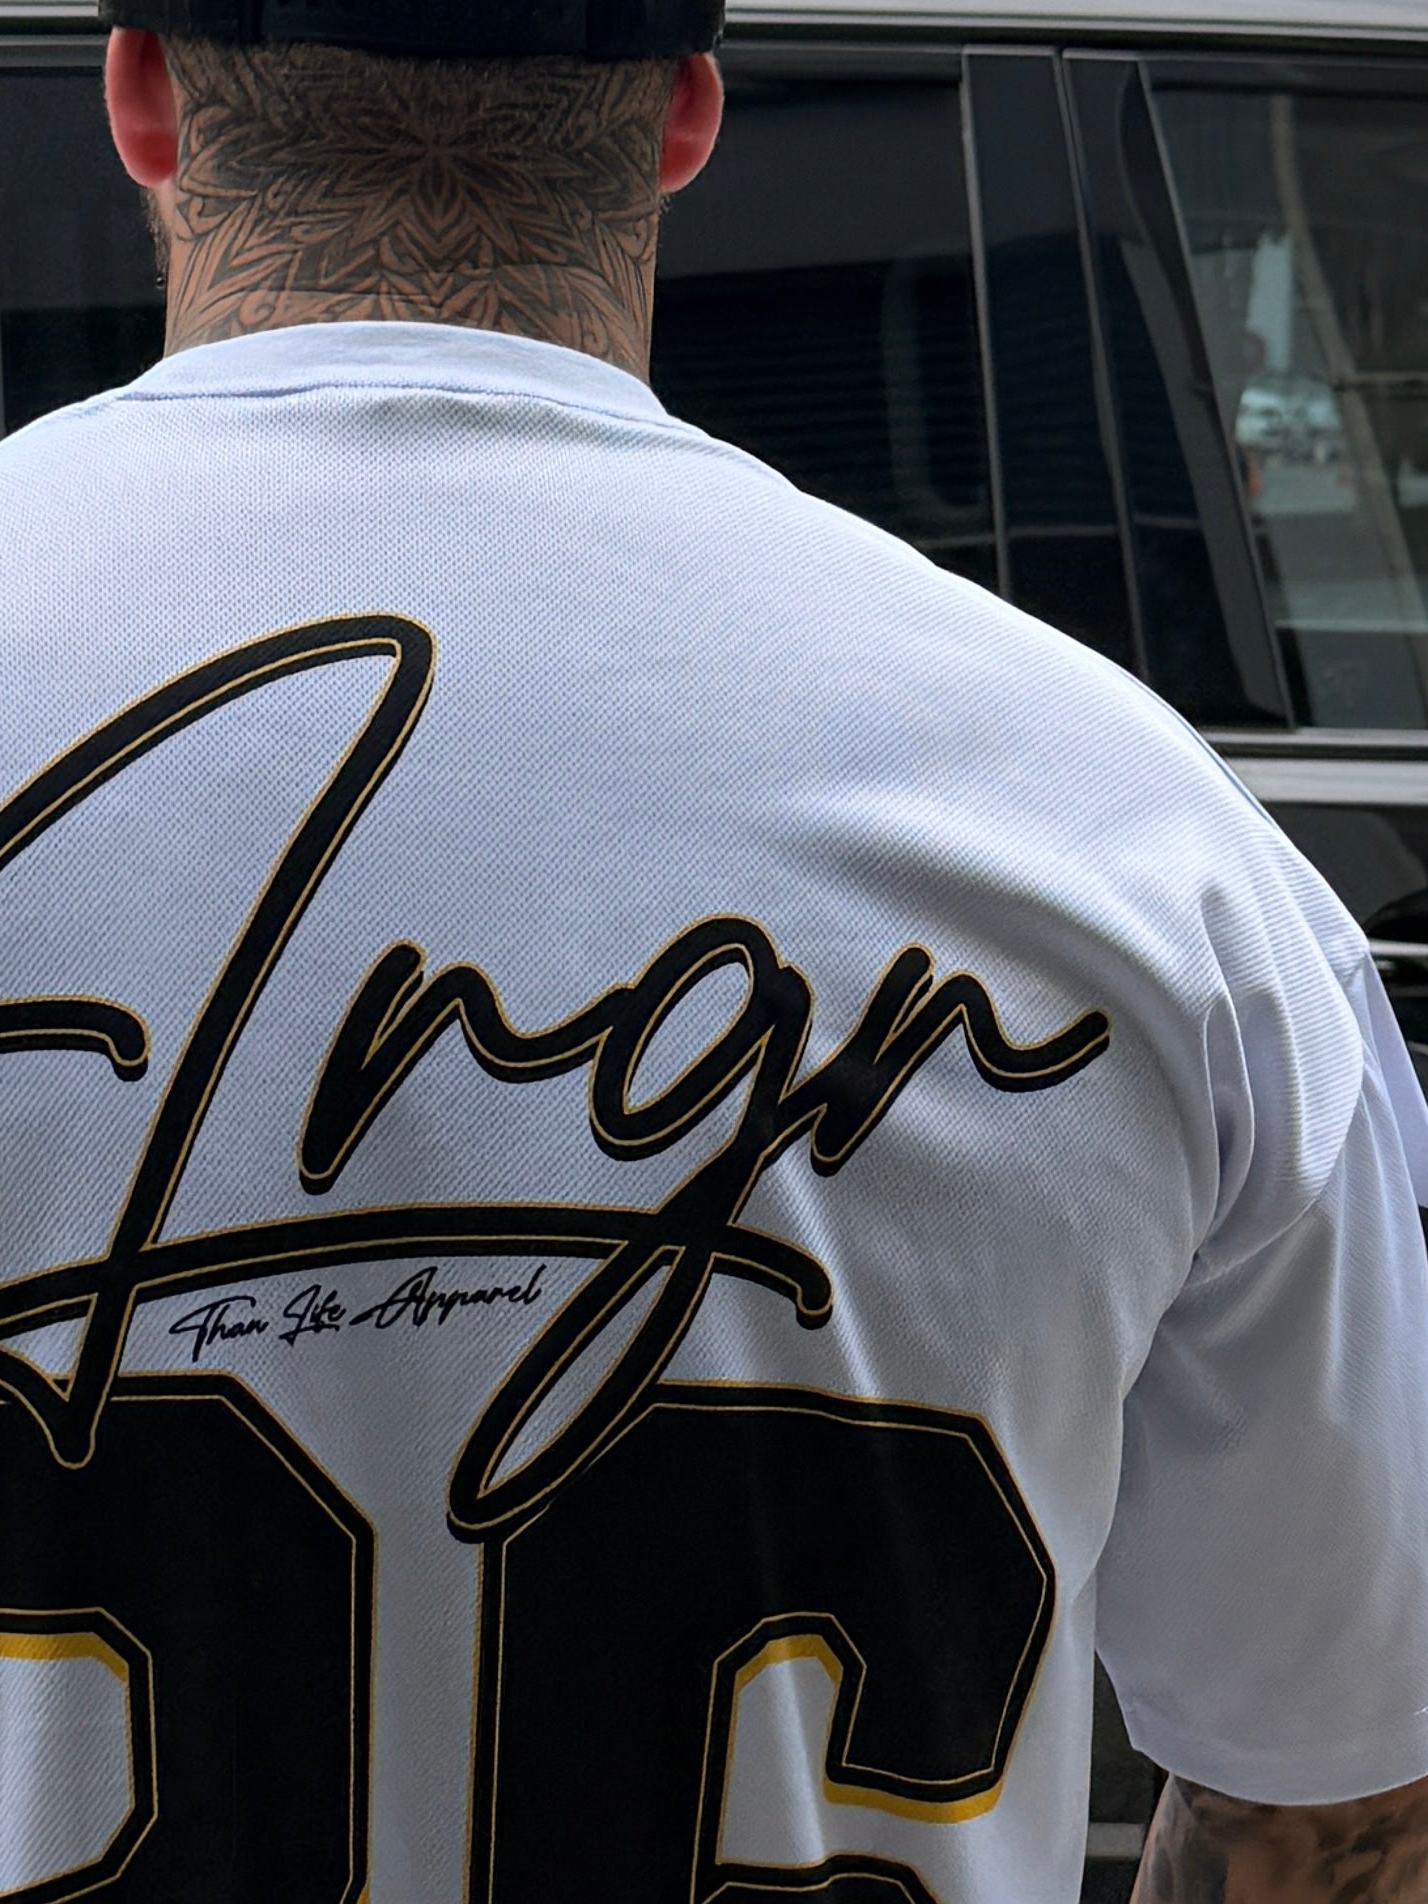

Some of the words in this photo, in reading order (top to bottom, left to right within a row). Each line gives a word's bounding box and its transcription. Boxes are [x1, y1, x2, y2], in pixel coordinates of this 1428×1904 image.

[170, 1295, 269, 1362] Than
[278, 1284, 346, 1346] Life
[350, 1265, 547, 1328] Apparel
